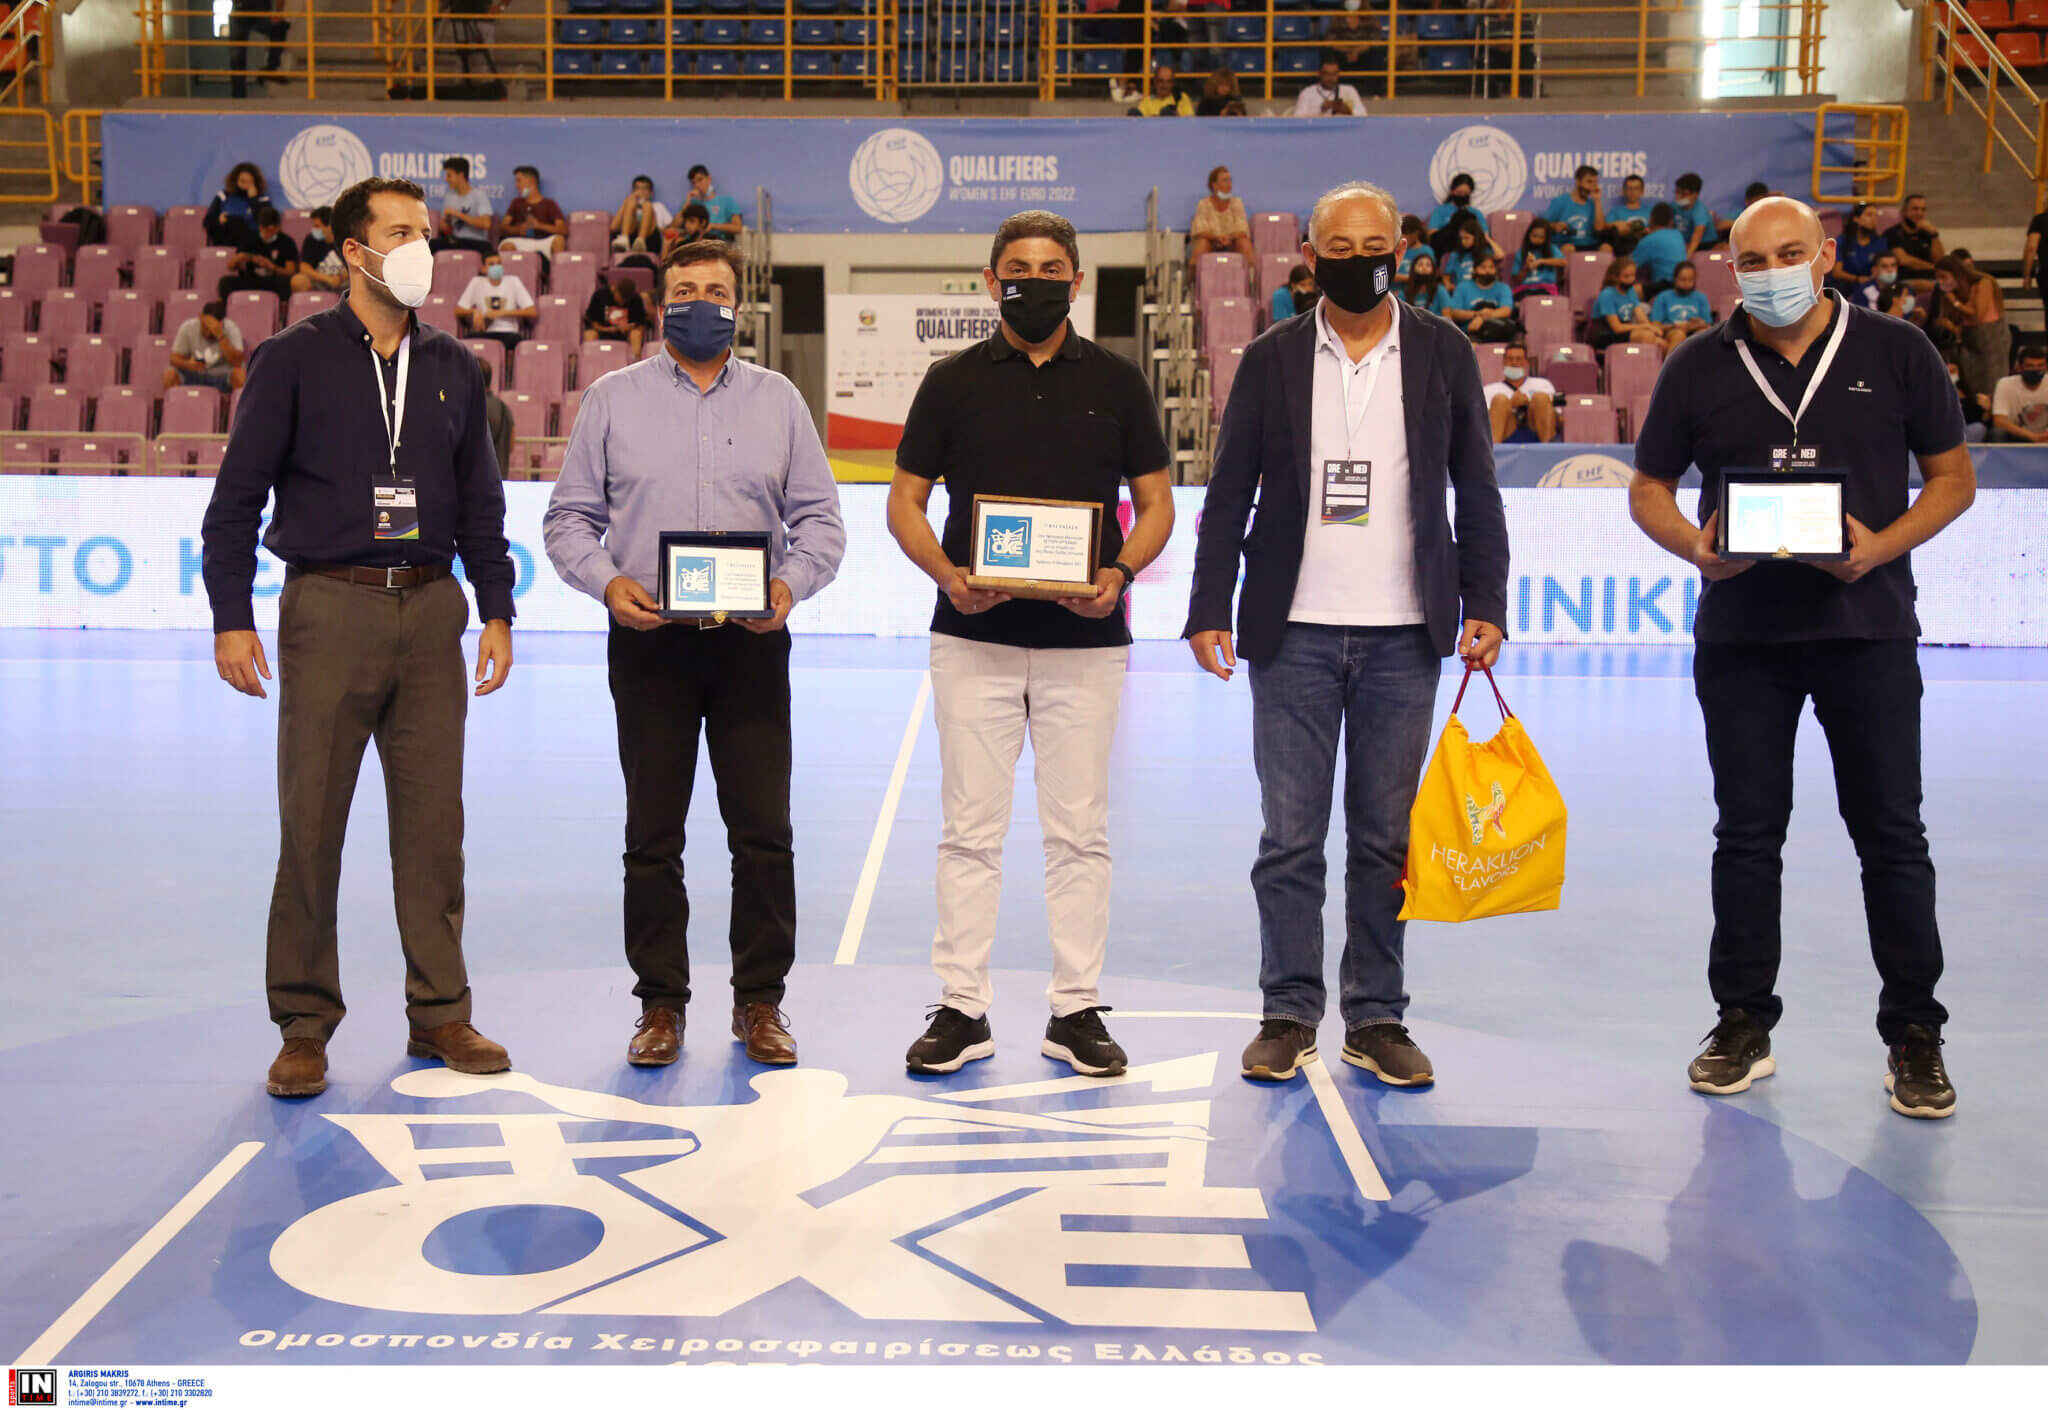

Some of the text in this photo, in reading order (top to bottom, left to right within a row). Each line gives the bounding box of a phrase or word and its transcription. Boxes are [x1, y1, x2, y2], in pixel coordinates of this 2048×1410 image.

[379, 152, 488, 179] QUALIFS
[949, 155, 1059, 185] QUALIFIERS
[949, 186, 1076, 201] WOMEN'S EHF EURO 2022
[1800, 448, 1817, 459] NED
[1576, 464, 1604, 481] EHF
[1431, 832, 1547, 875] HERAKLION
[1453, 862, 1520, 892] FLAVORS
[238, 1329, 1326, 1366] Ομοσπονδία Χειροσφαιρίσεως Ελλάδος
